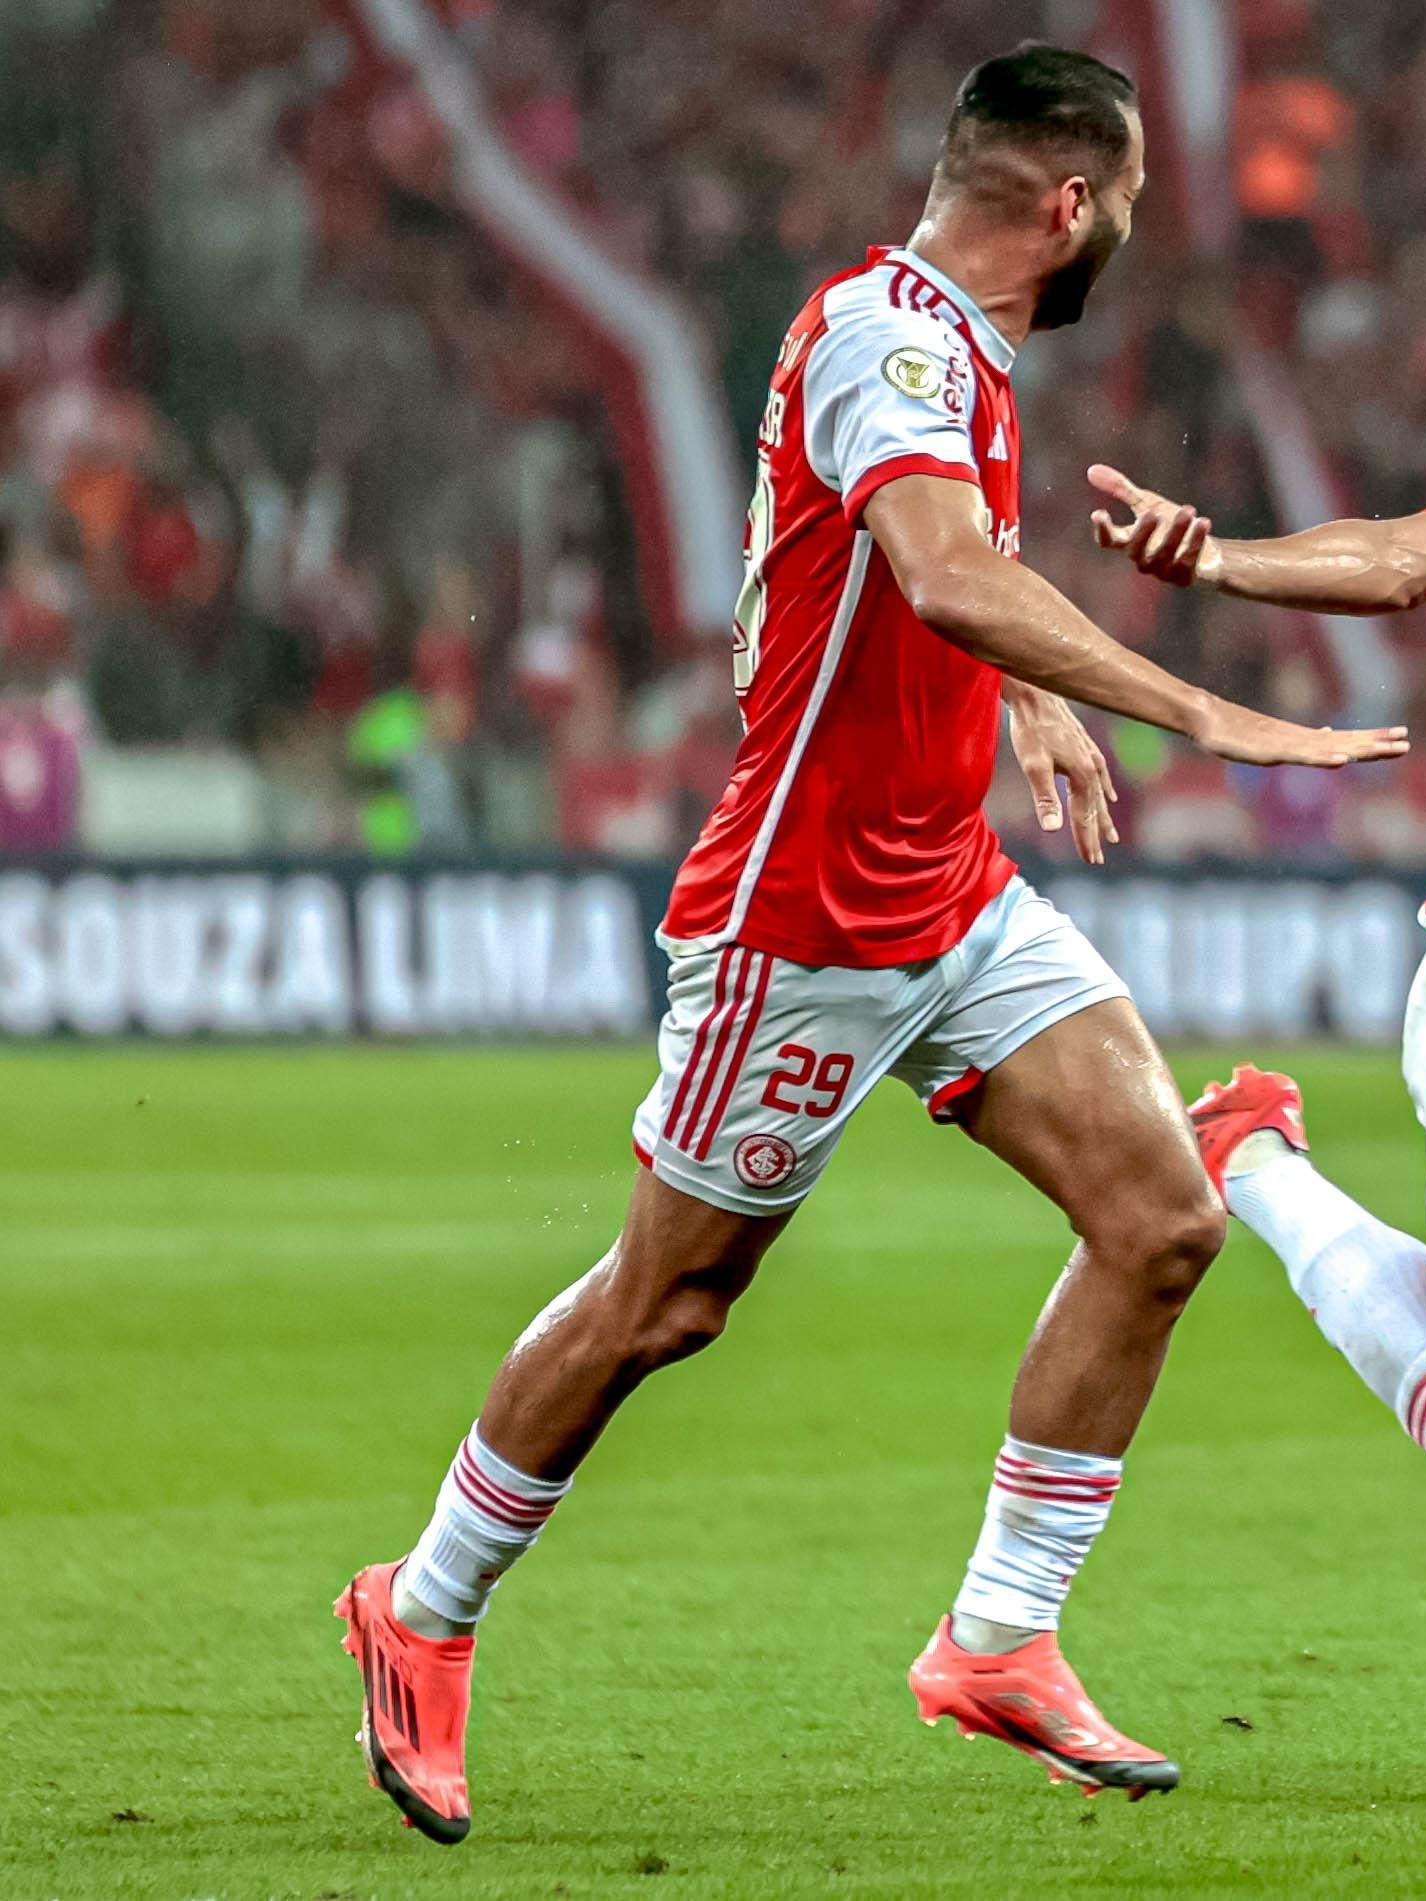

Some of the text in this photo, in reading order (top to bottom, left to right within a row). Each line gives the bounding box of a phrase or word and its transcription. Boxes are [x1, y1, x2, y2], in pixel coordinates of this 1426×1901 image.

[0, 872, 651, 1032] SOUZA LIMA
[760, 1043, 855, 1119] 29
